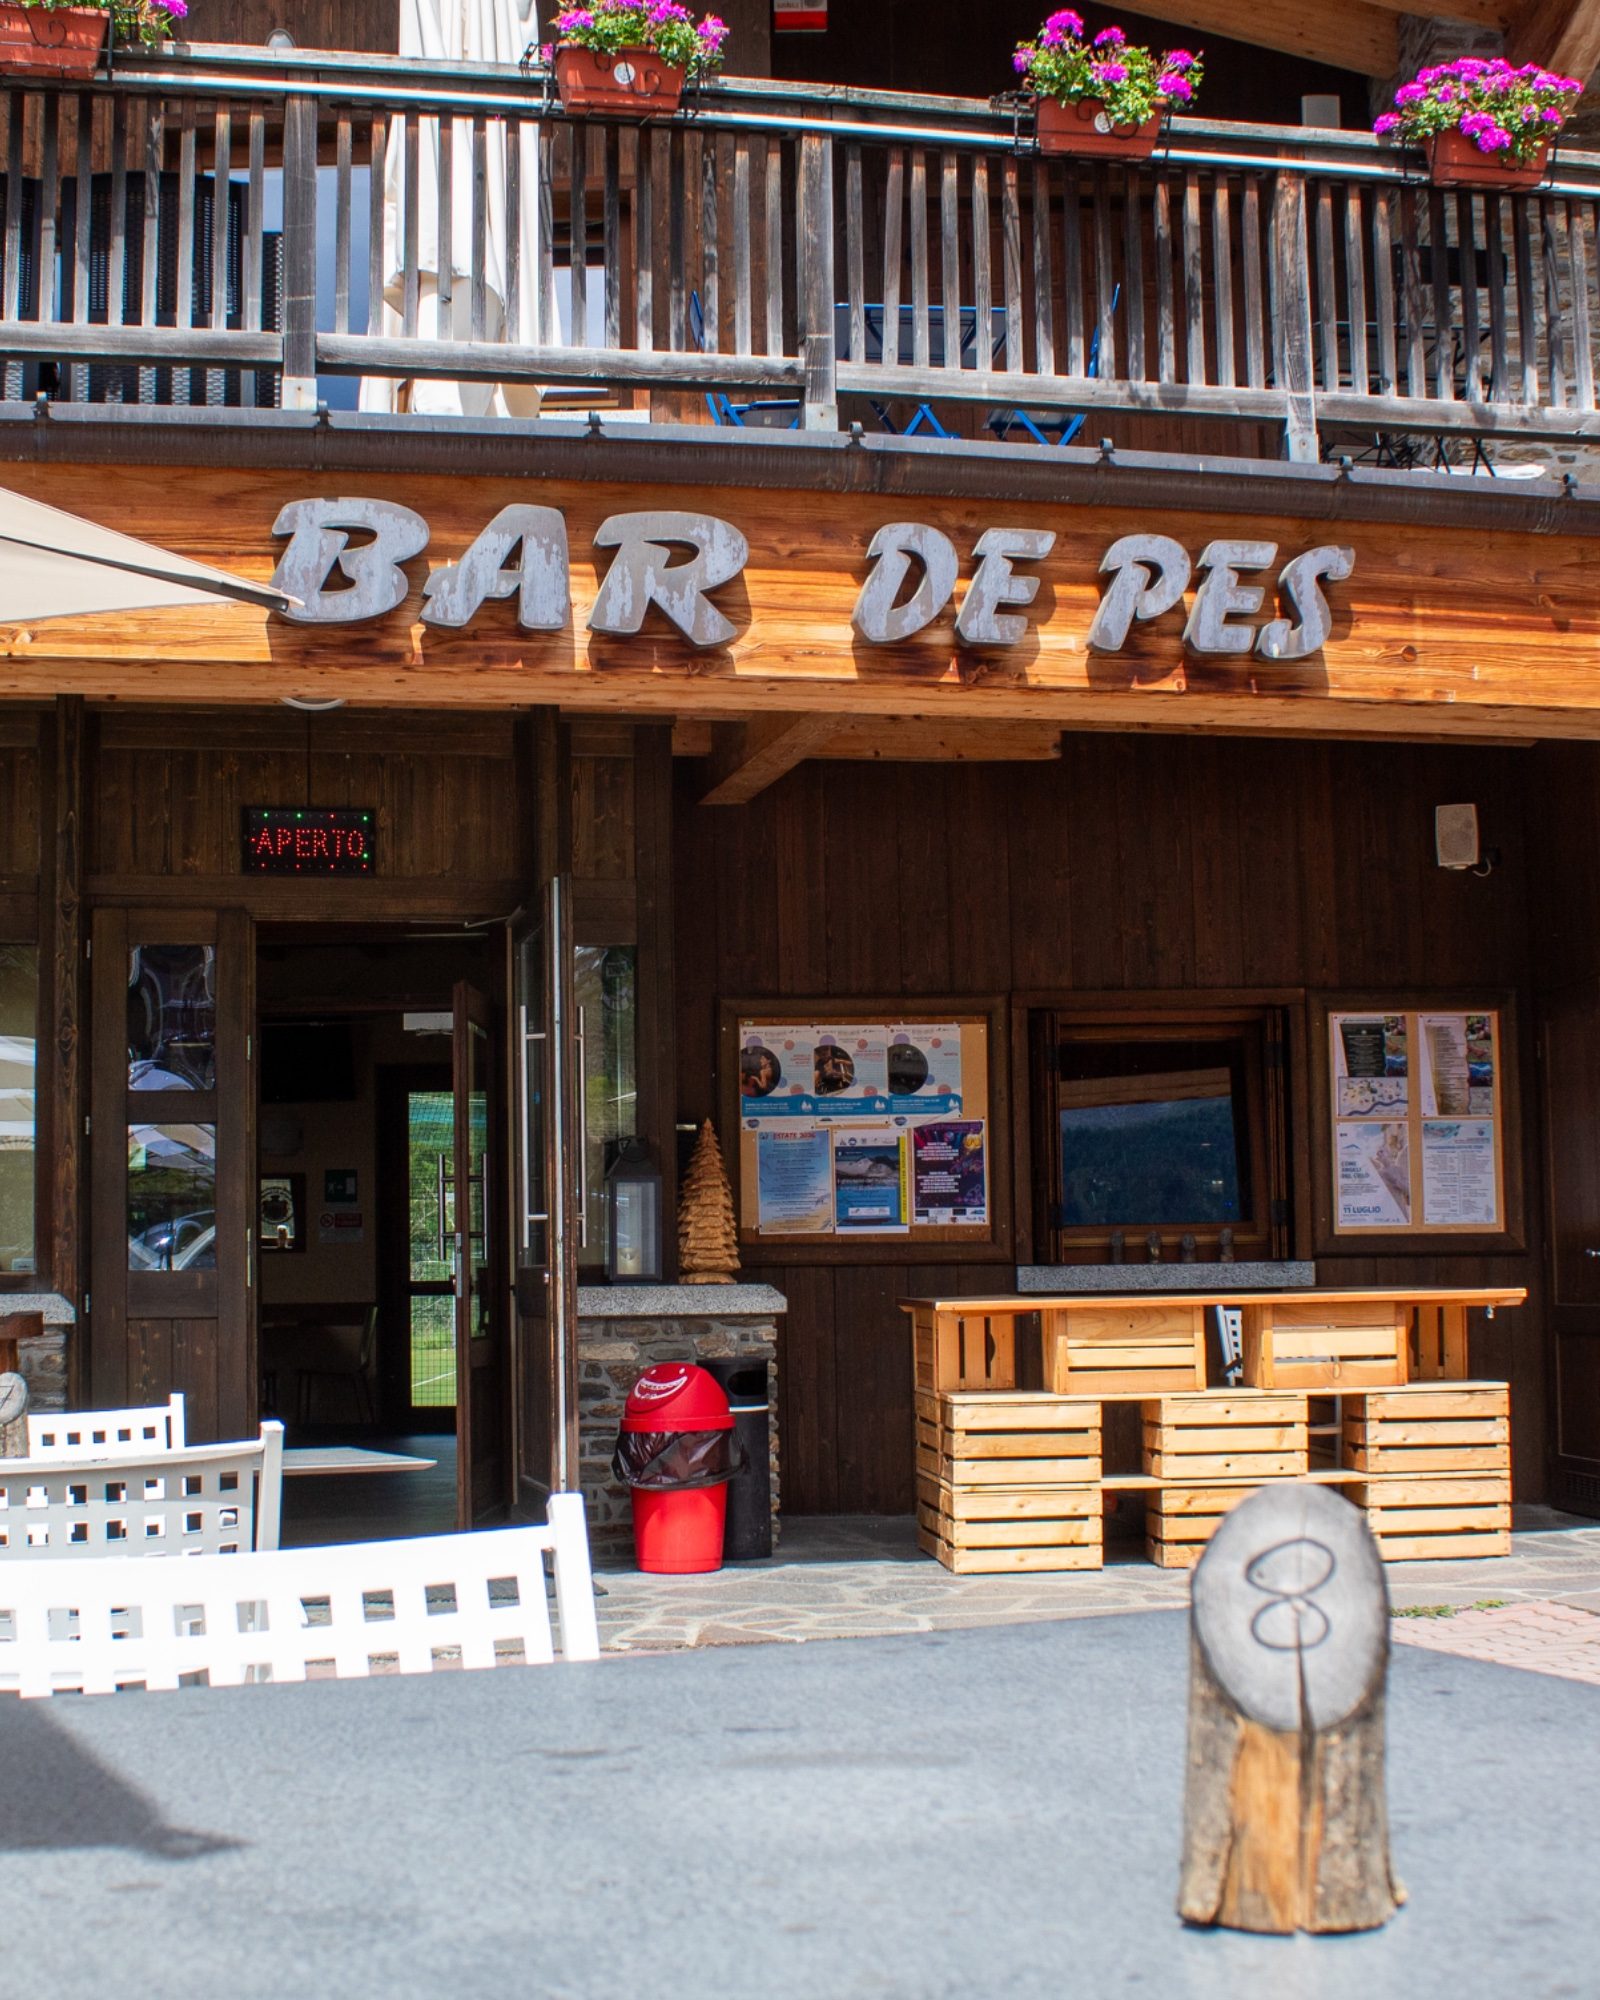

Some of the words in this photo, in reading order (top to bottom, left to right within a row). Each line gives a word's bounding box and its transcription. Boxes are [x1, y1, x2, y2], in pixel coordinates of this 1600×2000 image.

[268, 496, 749, 647] BAR
[851, 521, 1057, 647] DE
[1087, 533, 1356, 660] PES
[256, 827, 365, 858] APERTO
[1352, 1205, 1381, 1214] LUGLIO
[1244, 1536, 1335, 1651] 8
